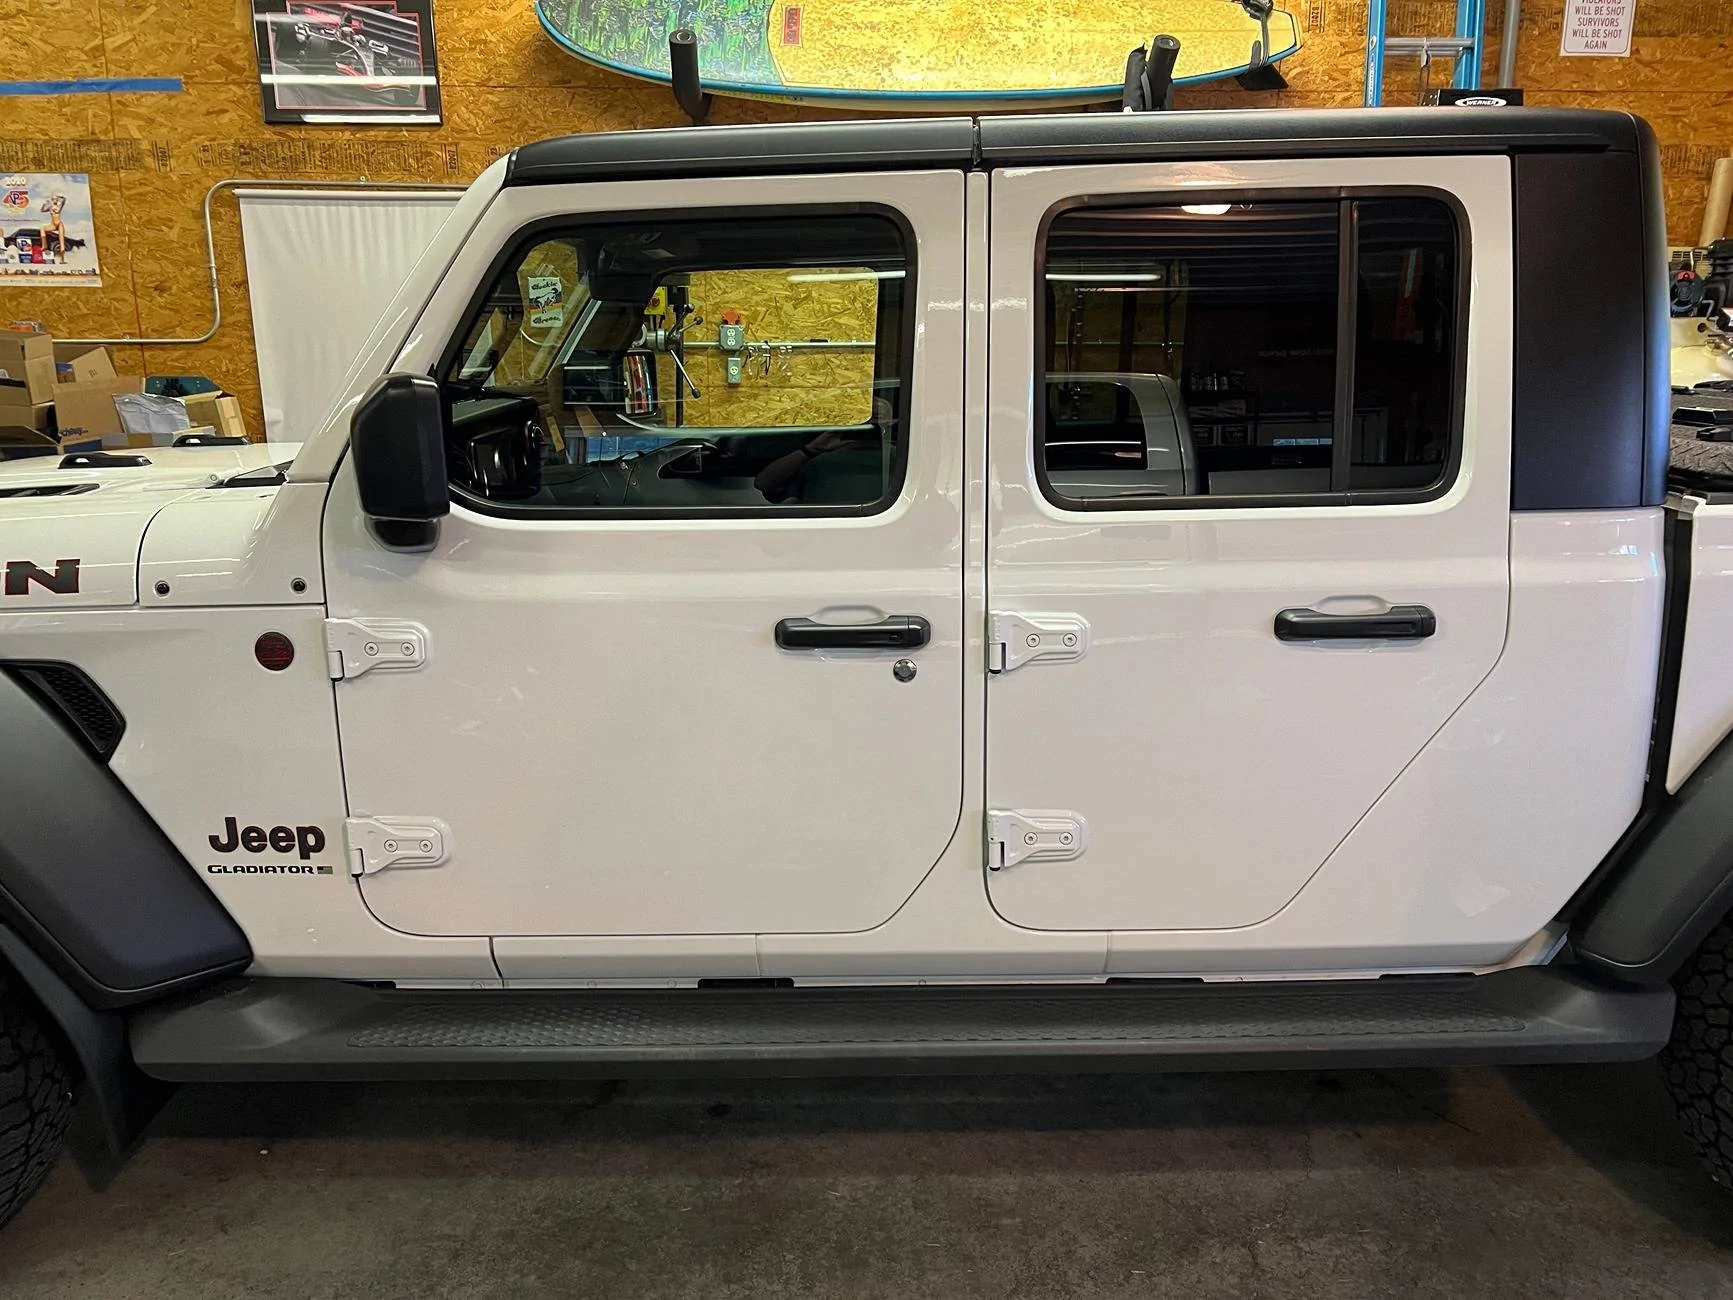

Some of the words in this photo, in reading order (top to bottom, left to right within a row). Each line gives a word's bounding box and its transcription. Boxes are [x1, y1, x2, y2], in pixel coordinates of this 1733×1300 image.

[1575, 6, 1591, 16] WILL
[1594, 6, 1605, 16] BE
[1606, 6, 1626, 16] SHOT
[1577, 17, 1620, 27] SURVIVORS
[1572, 28, 1589, 38] WILL
[1591, 28, 1601, 38] BE
[1603, 29, 1623, 39] SHOT
[1583, 40, 1608, 50] AGAIN
[5, 176, 26, 187] 2020
[208, 816, 326, 860] Jeep
[207, 864, 315, 875] GLADIATOR
